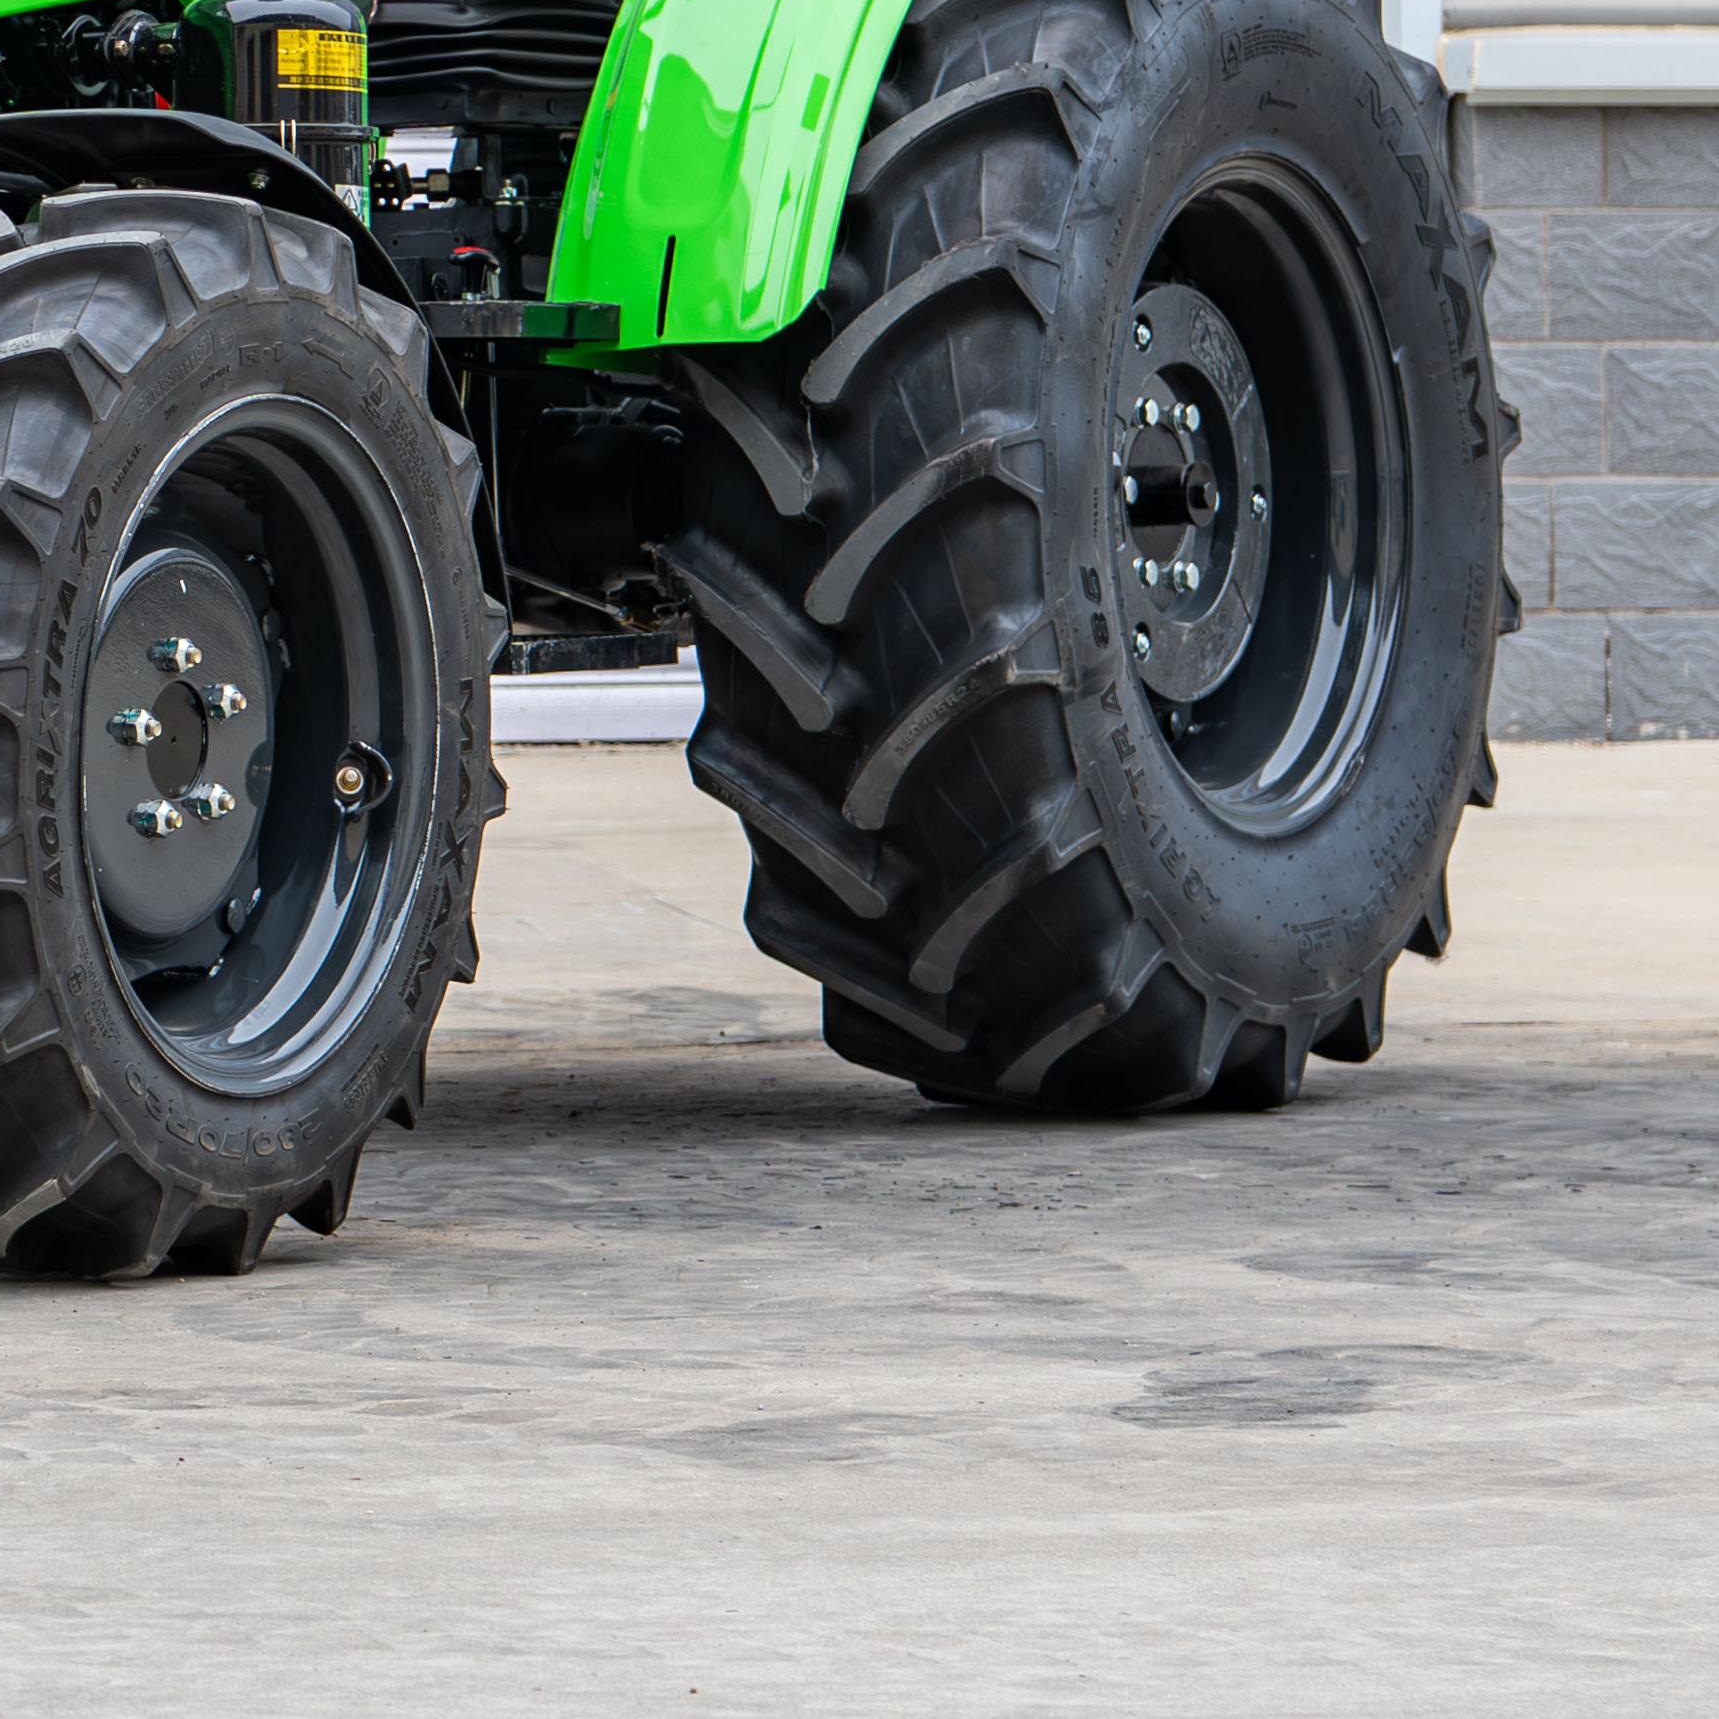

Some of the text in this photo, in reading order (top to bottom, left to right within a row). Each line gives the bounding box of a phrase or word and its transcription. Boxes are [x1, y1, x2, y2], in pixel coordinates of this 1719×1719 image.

[1356, 70, 1488, 461] MAXAM
[36, 485, 103, 899] AGRIXTRA 70
[402, 677, 473, 1014] MAXAM
[1081, 564, 1221, 923] AGRIXTRA 85
